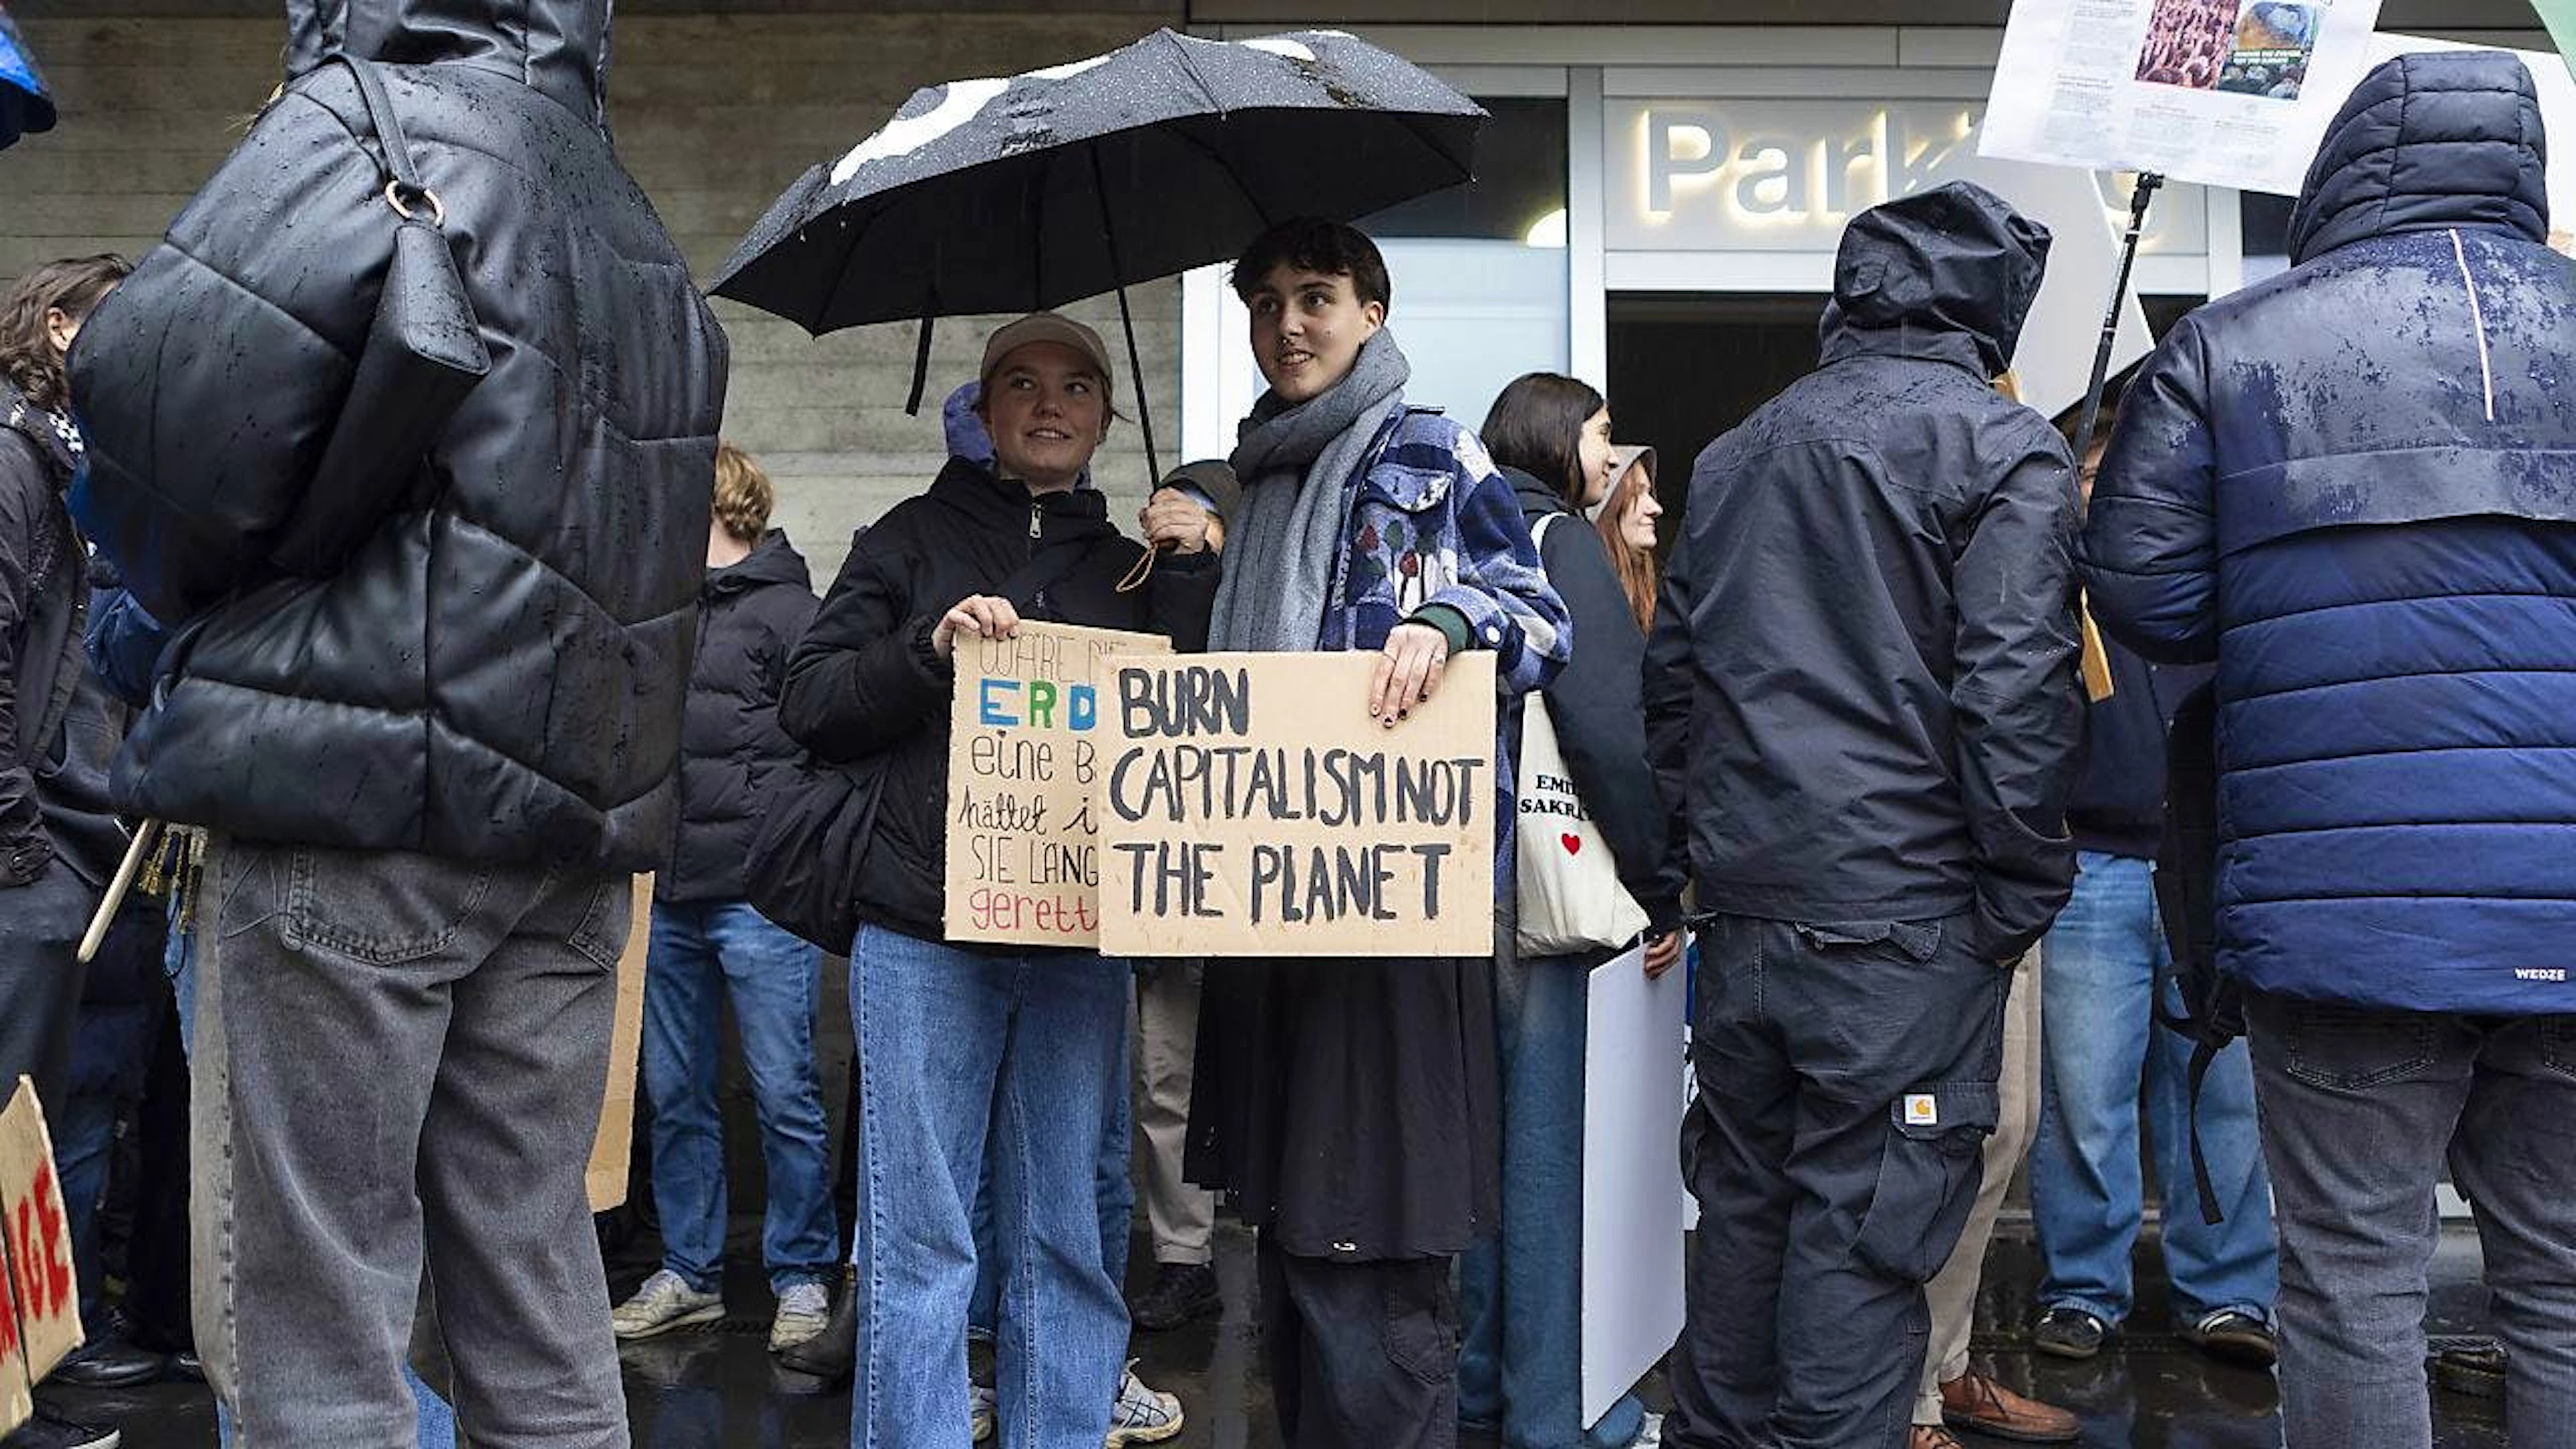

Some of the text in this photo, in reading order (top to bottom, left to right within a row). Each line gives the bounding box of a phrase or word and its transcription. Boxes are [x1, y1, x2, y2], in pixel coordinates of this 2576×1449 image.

[979, 678, 1096, 731] ERD
[1119, 666, 1248, 738] BURN
[972, 729, 1097, 784] eine B
[1110, 745, 1485, 828] CAPITALISM NOT
[1063, 797, 1098, 835] i
[971, 835, 1099, 887] SIE LÄNG
[1112, 841, 1452, 926] THE PLANET
[970, 889, 1098, 932] gerett
[2514, 967, 2566, 981] WEDZE
